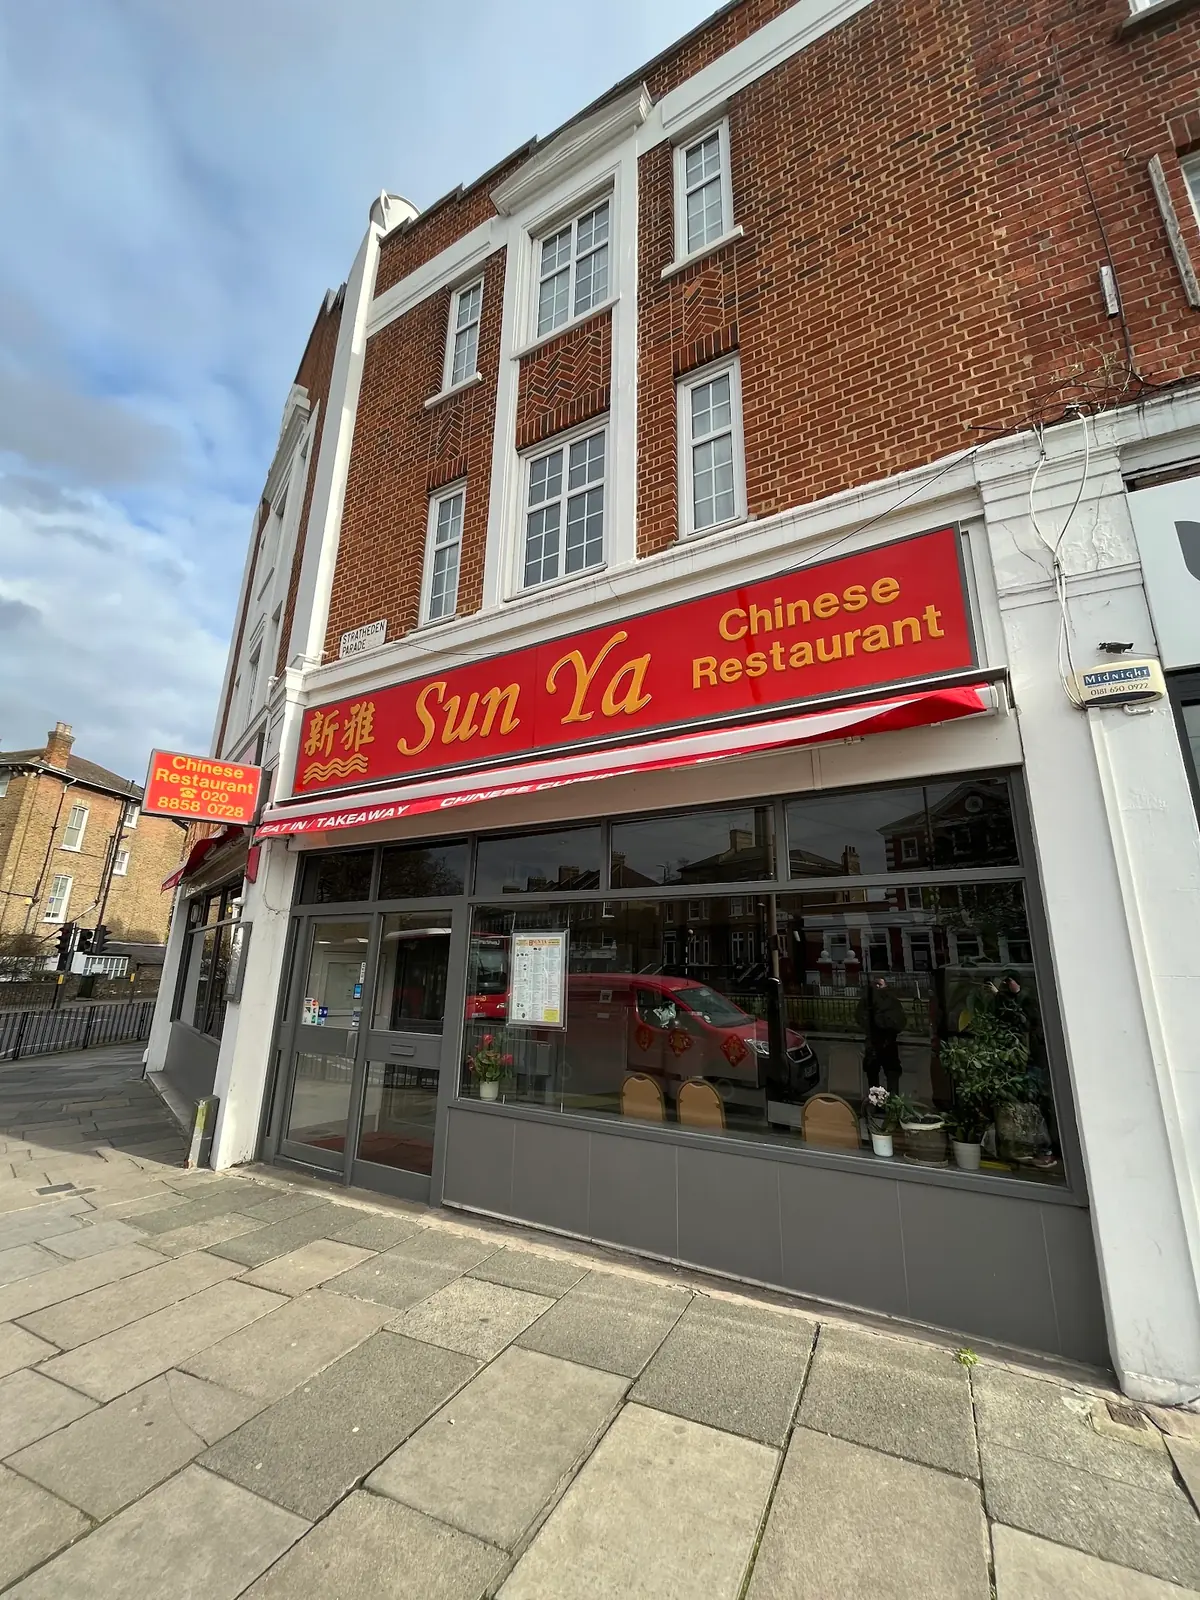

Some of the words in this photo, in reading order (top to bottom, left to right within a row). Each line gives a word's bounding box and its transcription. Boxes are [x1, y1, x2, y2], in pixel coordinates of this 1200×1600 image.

[719, 577, 900, 642] Chinese
[342, 620, 385, 645] STRATHEDEN
[342, 639, 367, 655] PARADE
[692, 604, 945, 689] Restaurant
[397, 681, 521, 756] Sun
[546, 631, 652, 725] Ya
[1090, 688, 1107, 696] 0181
[303, 700, 376, 758] 新雅
[172, 756, 244, 779] Chinese
[155, 768, 254, 795] Restaurant
[157, 796, 201, 813] 8858
[207, 803, 244, 818] 0728
[201, 790, 229, 803] 020
[440, 785, 535, 807] CHINESE
[317, 804, 411, 828] TAKEAWAY
